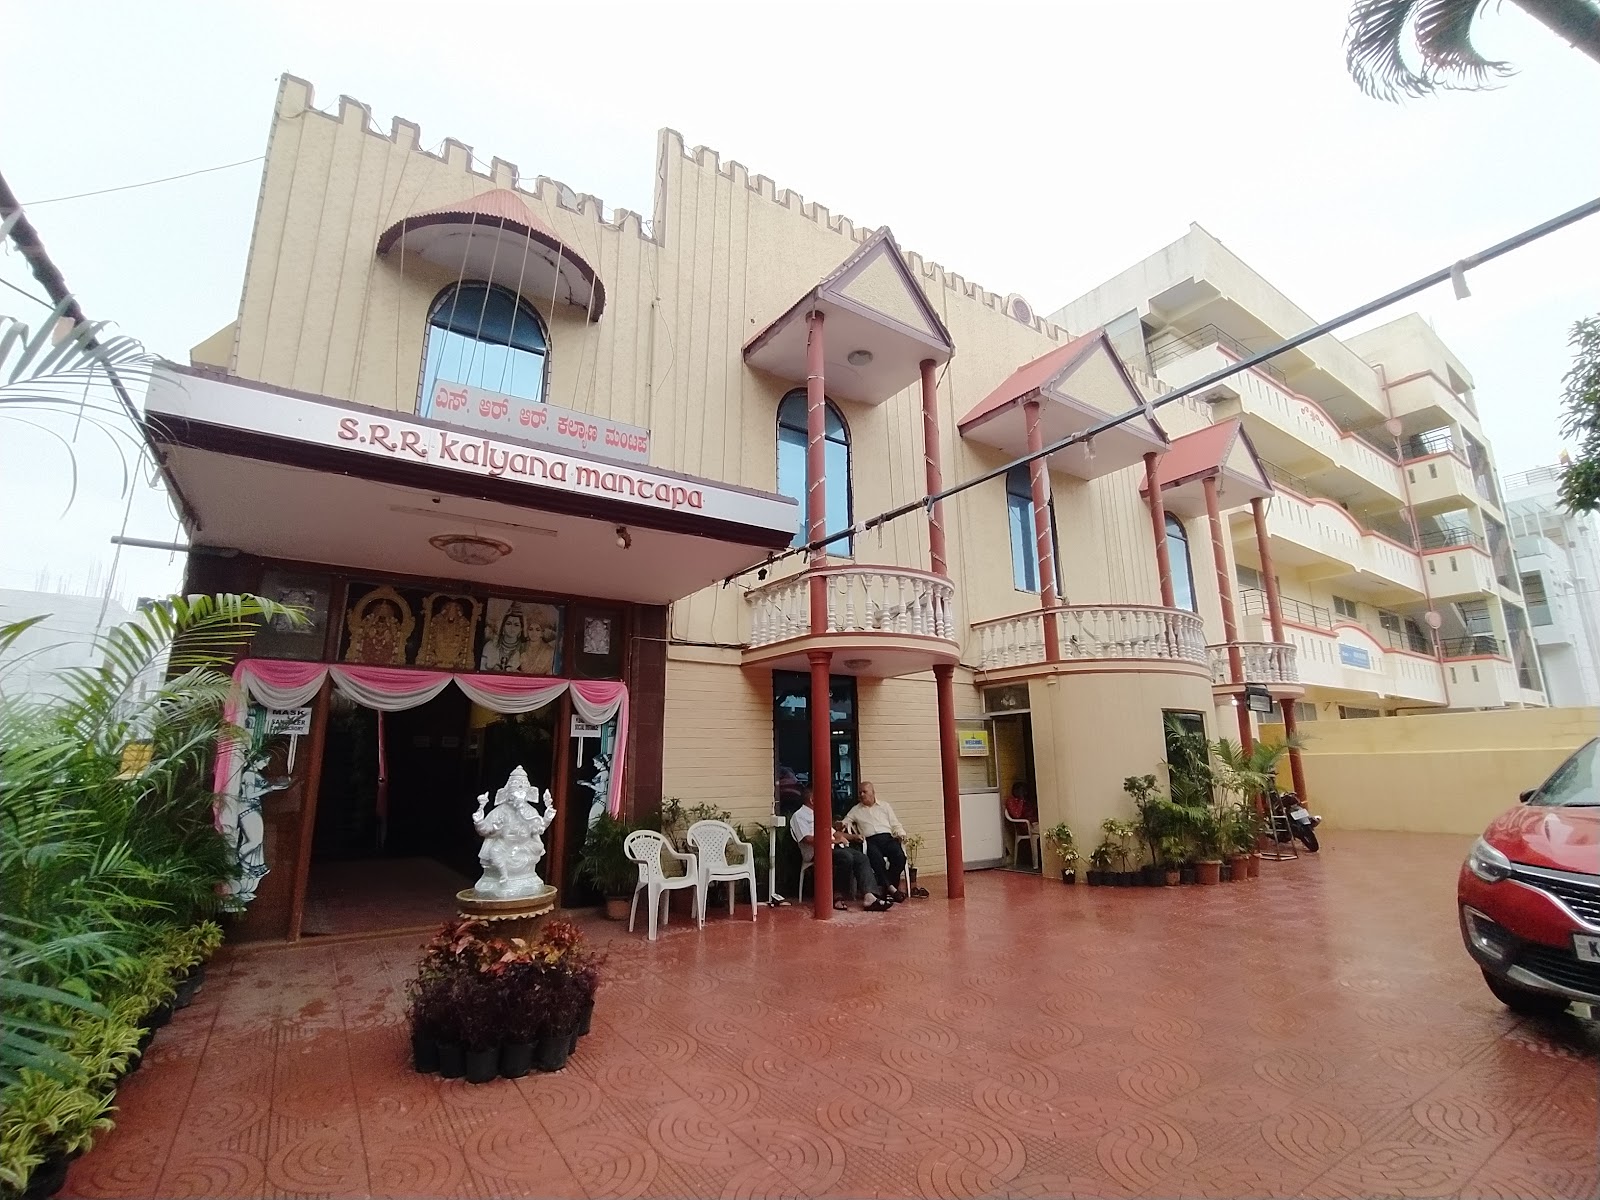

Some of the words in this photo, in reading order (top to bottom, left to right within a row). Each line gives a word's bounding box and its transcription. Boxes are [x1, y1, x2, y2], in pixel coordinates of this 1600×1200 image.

[337, 417, 428, 458] S.R.R.
[438, 431, 569, 482] kalyana
[575, 465, 703, 509] mantapa
[557, 415, 598, 449] ಕಲ್ಯಾಣ
[605, 427, 648, 453] ಮಂಟಪ
